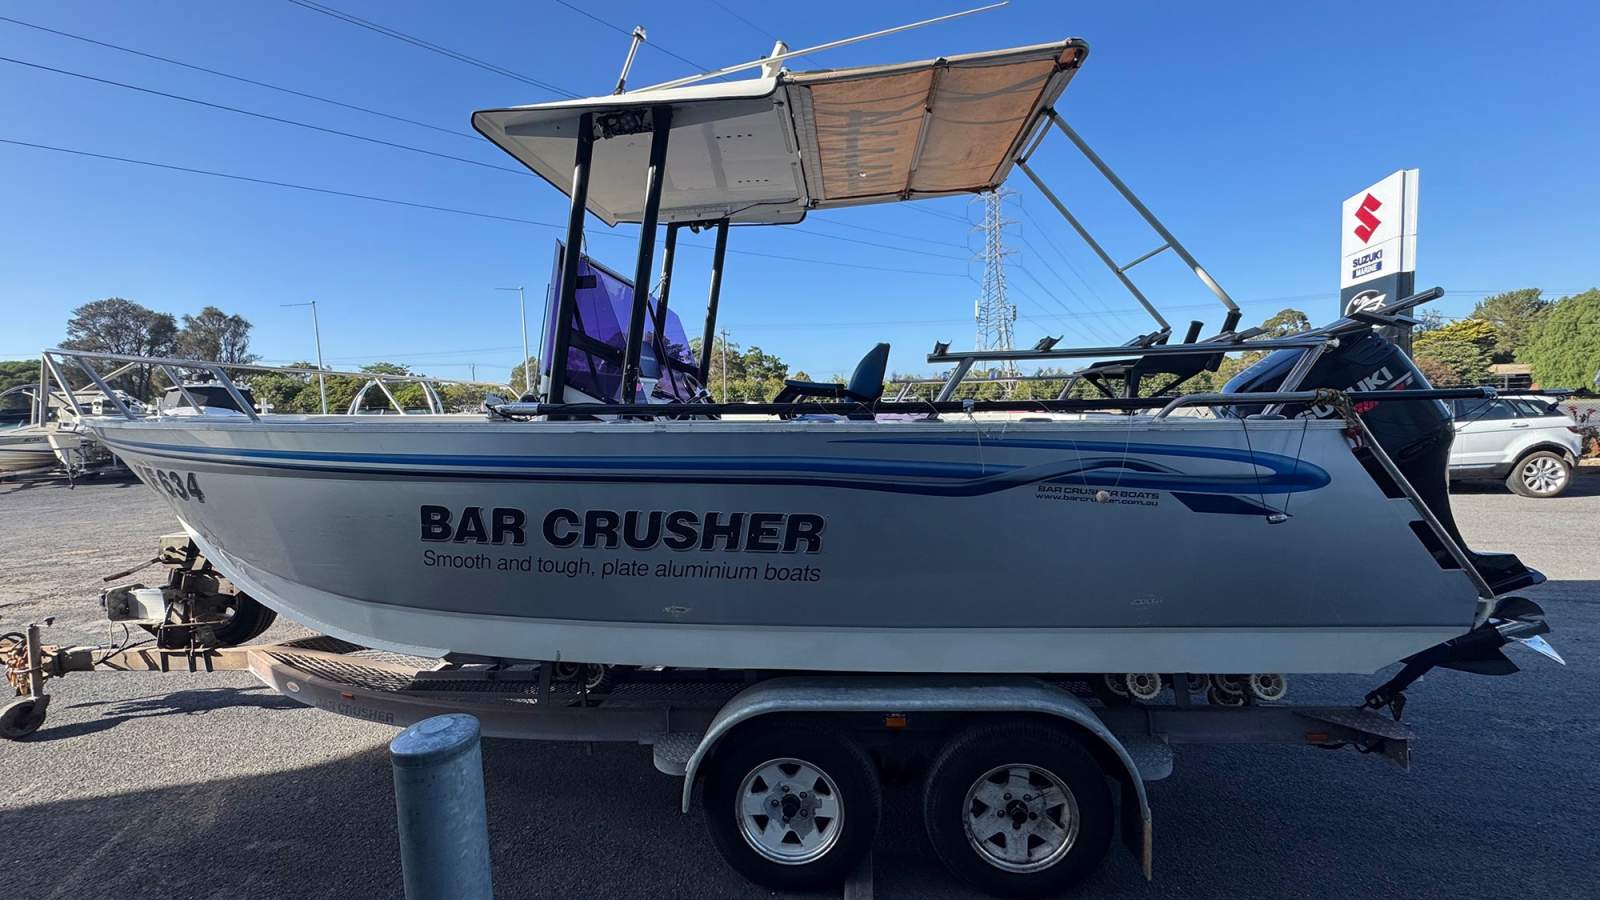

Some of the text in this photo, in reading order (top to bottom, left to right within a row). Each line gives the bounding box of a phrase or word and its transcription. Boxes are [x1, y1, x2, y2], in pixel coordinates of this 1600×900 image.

[1353, 249, 1383, 268] SUZUKI
[1294, 366, 1393, 420] SUKI
[1035, 493, 1159, 506] www.barcruer.com.au
[1037, 485, 1160, 499] BAR CRUSR BOATS
[420, 505, 825, 554] BAR CRUSHER
[423, 550, 821, 582] Smooth and tough, plate aluminium boats
[338, 704, 394, 723] CRUSHER
